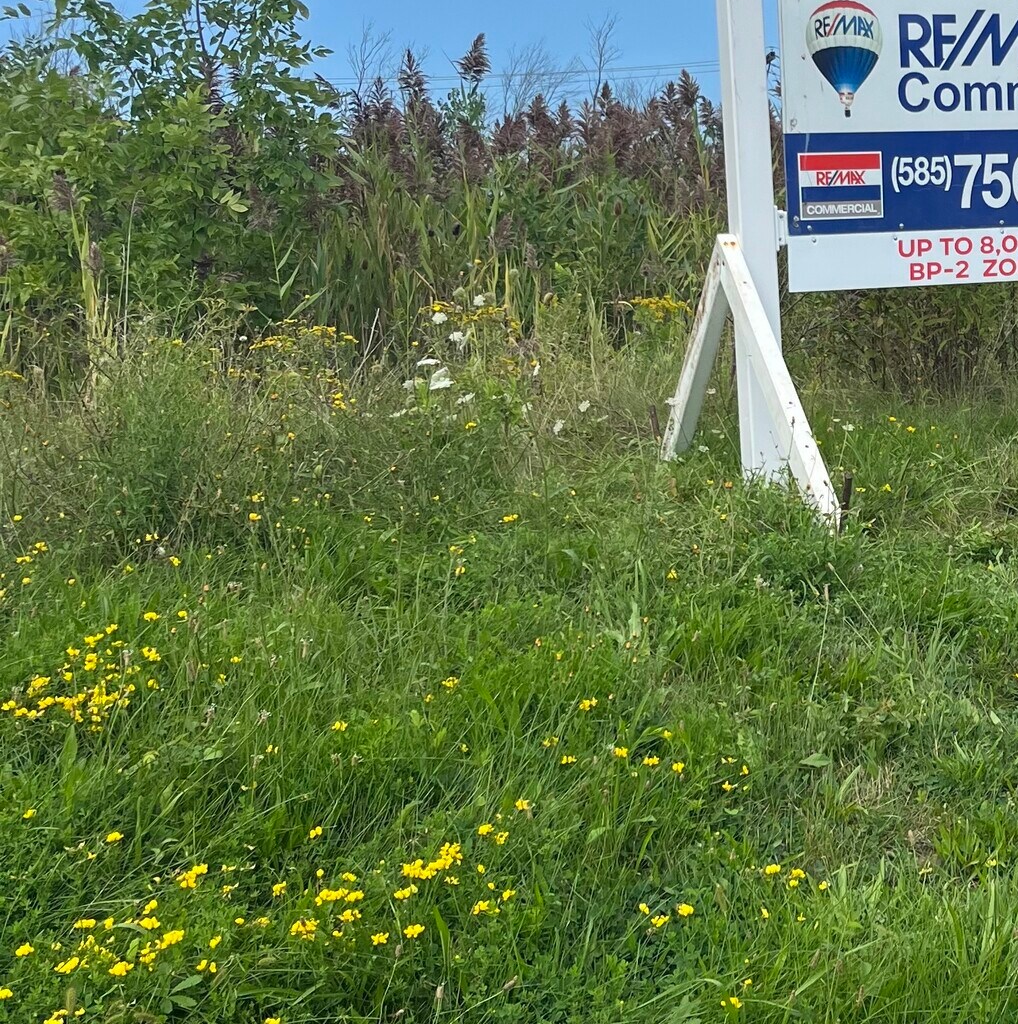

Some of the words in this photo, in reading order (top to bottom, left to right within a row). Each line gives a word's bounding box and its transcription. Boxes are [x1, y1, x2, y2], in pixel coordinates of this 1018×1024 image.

[814, 13, 875, 39] RE/MAX
[815, 170, 866, 187] RE/MAX
[806, 203, 878, 216] COMMERCIAL
[897, 239, 934, 259] UP
[939, 237, 972, 257] TO
[909, 260, 970, 282] BP-2
